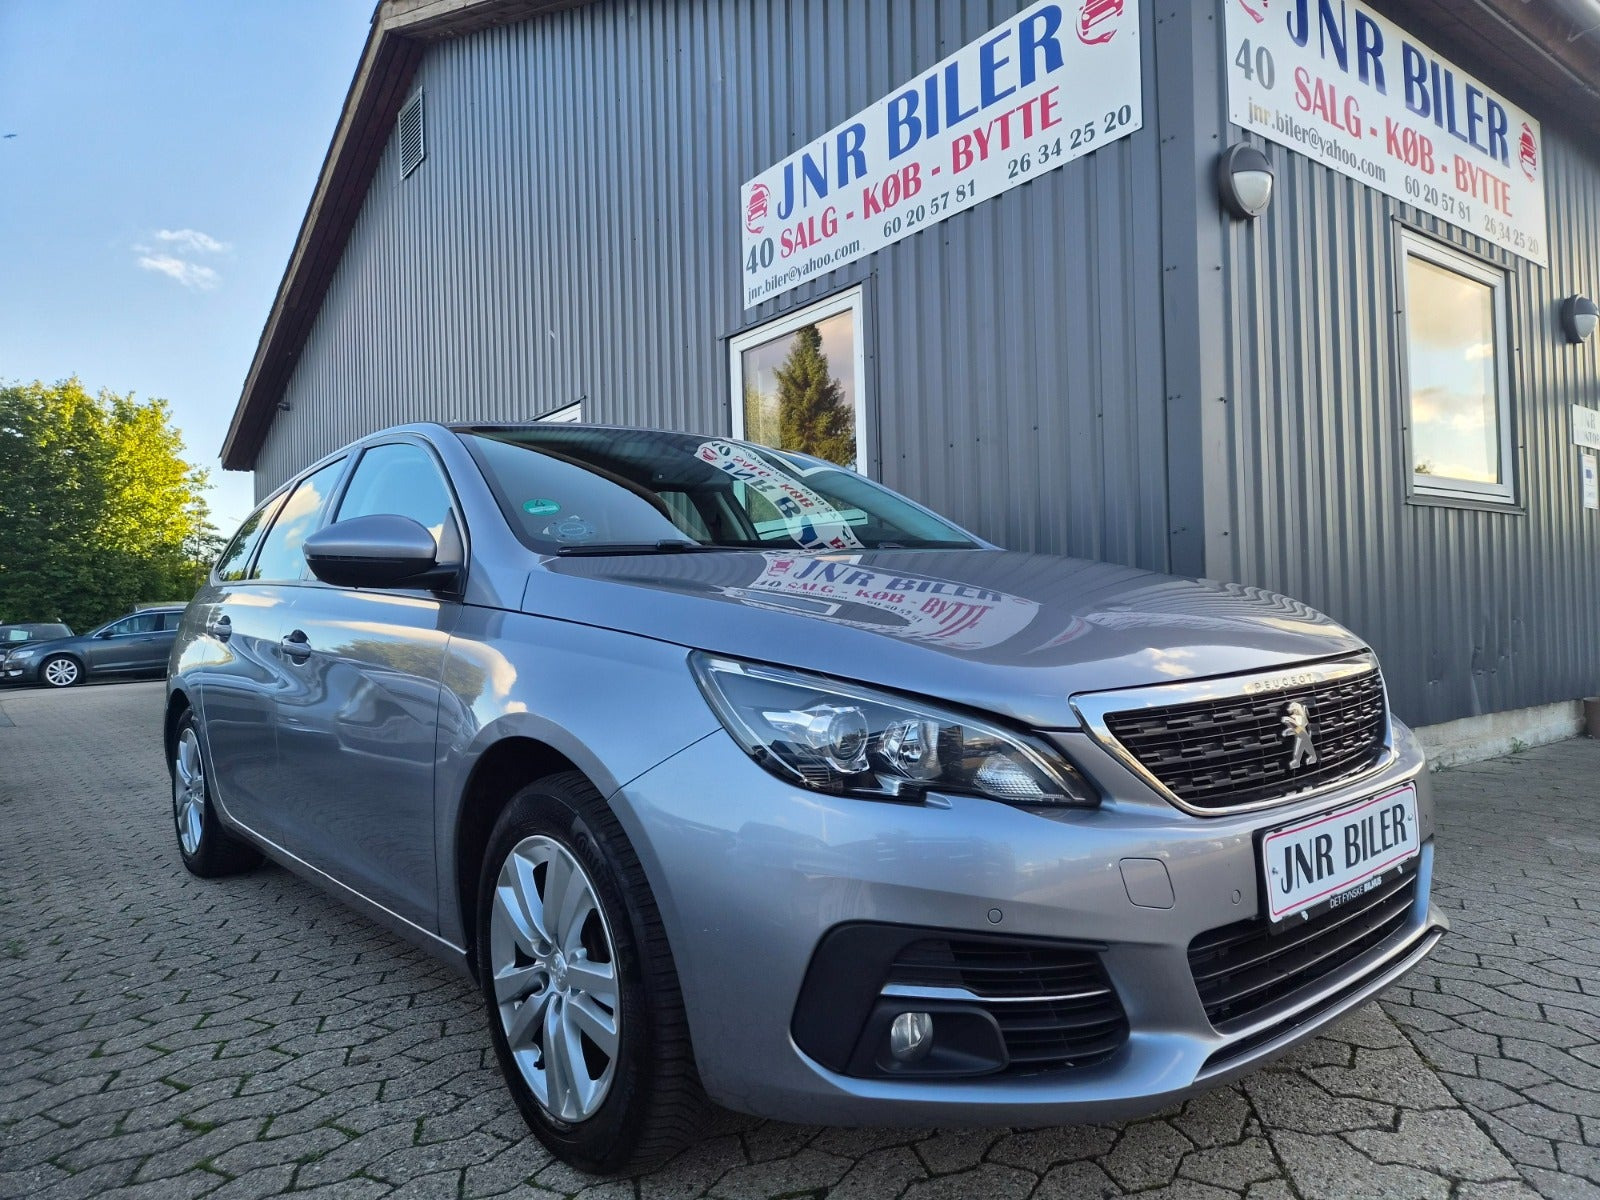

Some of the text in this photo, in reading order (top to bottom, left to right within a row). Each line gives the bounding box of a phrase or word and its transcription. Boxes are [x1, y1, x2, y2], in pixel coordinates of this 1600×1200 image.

[777, 4, 1064, 220] JNR BILER
[1235, 38, 1275, 90] 40
[1294, 66, 1362, 140] SALG
[1385, 115, 1435, 175] KØB
[1454, 153, 1513, 218] BYTTE
[1286, 0, 1511, 169] JNR BILER
[746, 237, 775, 275] 40
[780, 205, 838, 259] SALG
[863, 162, 923, 220] KØB
[952, 85, 1063, 175] BYTTE
[748, 104, 1132, 304] jnr.biler@yahoo.com 60 20 57 81 26 34 25 20
[1247, 96, 1539, 255] jnr.biler@yahoo.com 60 20 57 81 26 34 25 20
[793, 559, 876, 587] JNR
[1254, 673, 1312, 692] PEUGEOT
[1281, 803, 1408, 895] JNR BILER
[1330, 895, 1342, 909] DET
[1342, 885, 1364, 903] FYNSKE
